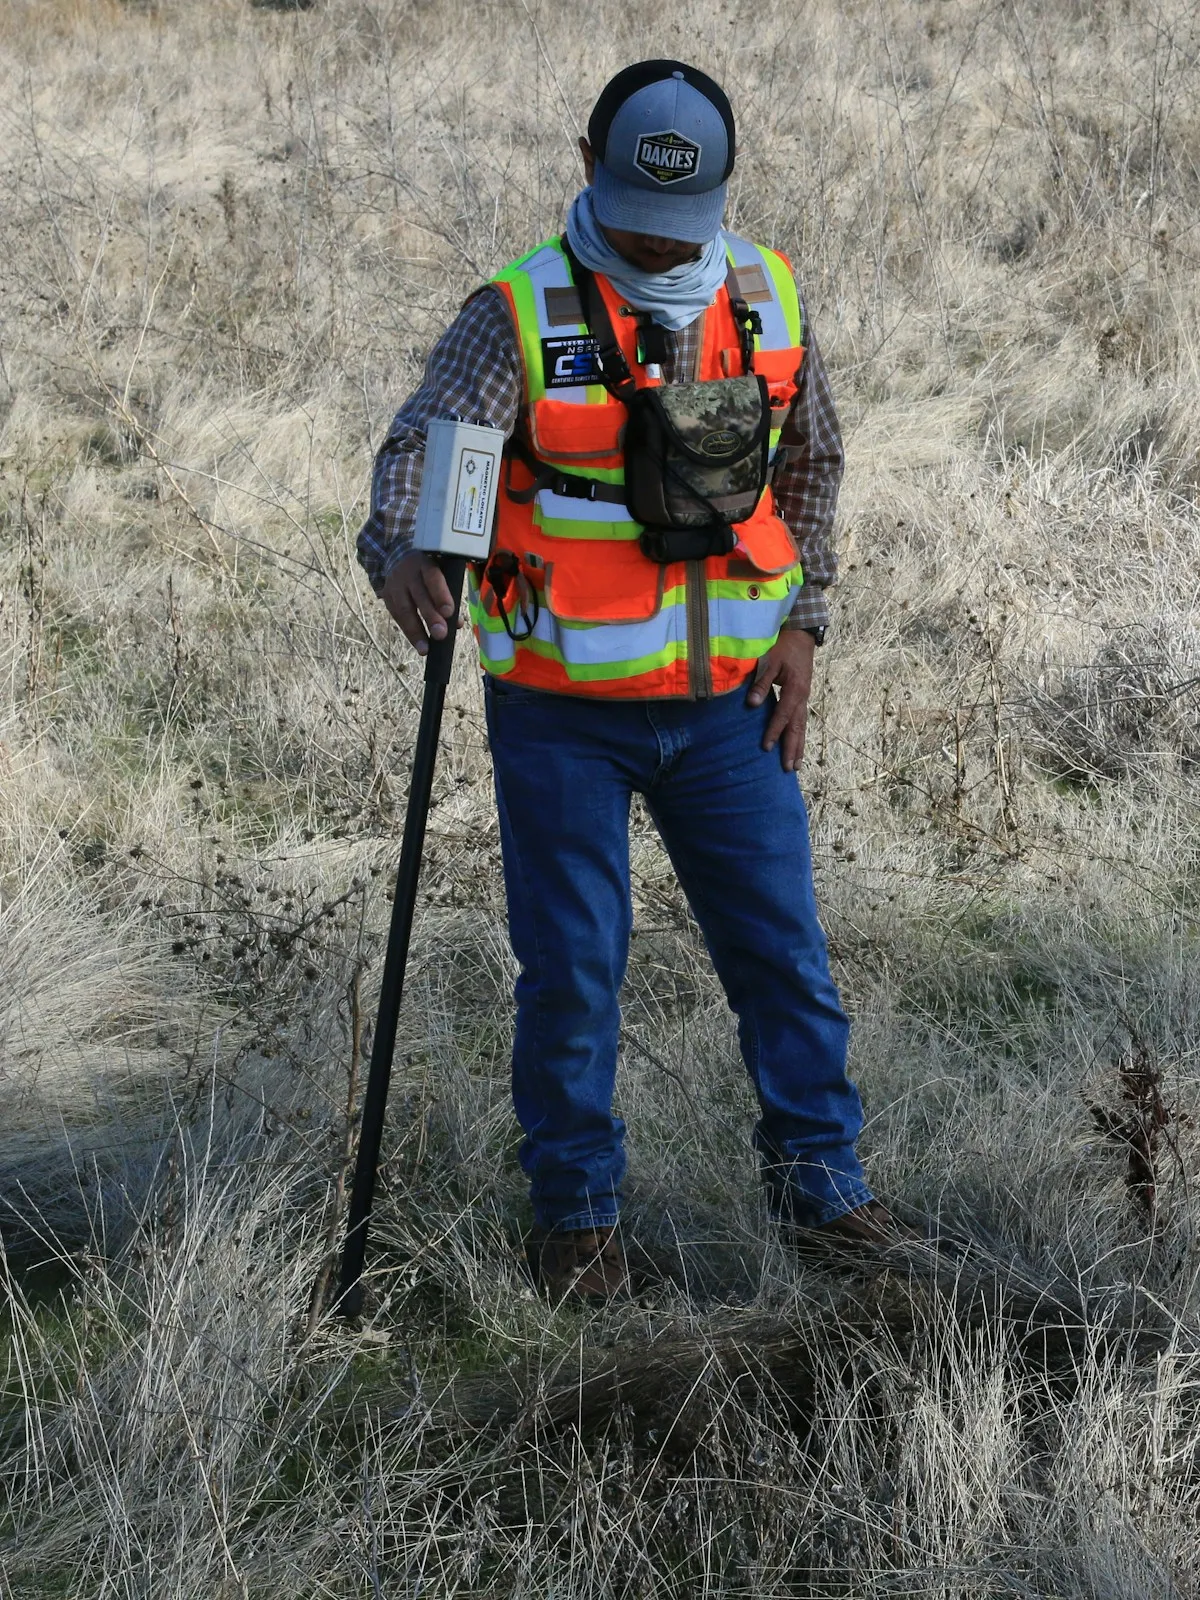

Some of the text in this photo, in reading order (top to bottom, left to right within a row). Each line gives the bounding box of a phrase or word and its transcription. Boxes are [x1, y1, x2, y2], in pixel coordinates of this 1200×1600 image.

[641, 143, 694, 169] OAKIES
[482, 460, 490, 496] MAGNETIC
[478, 497, 486, 529] LOCATOR
